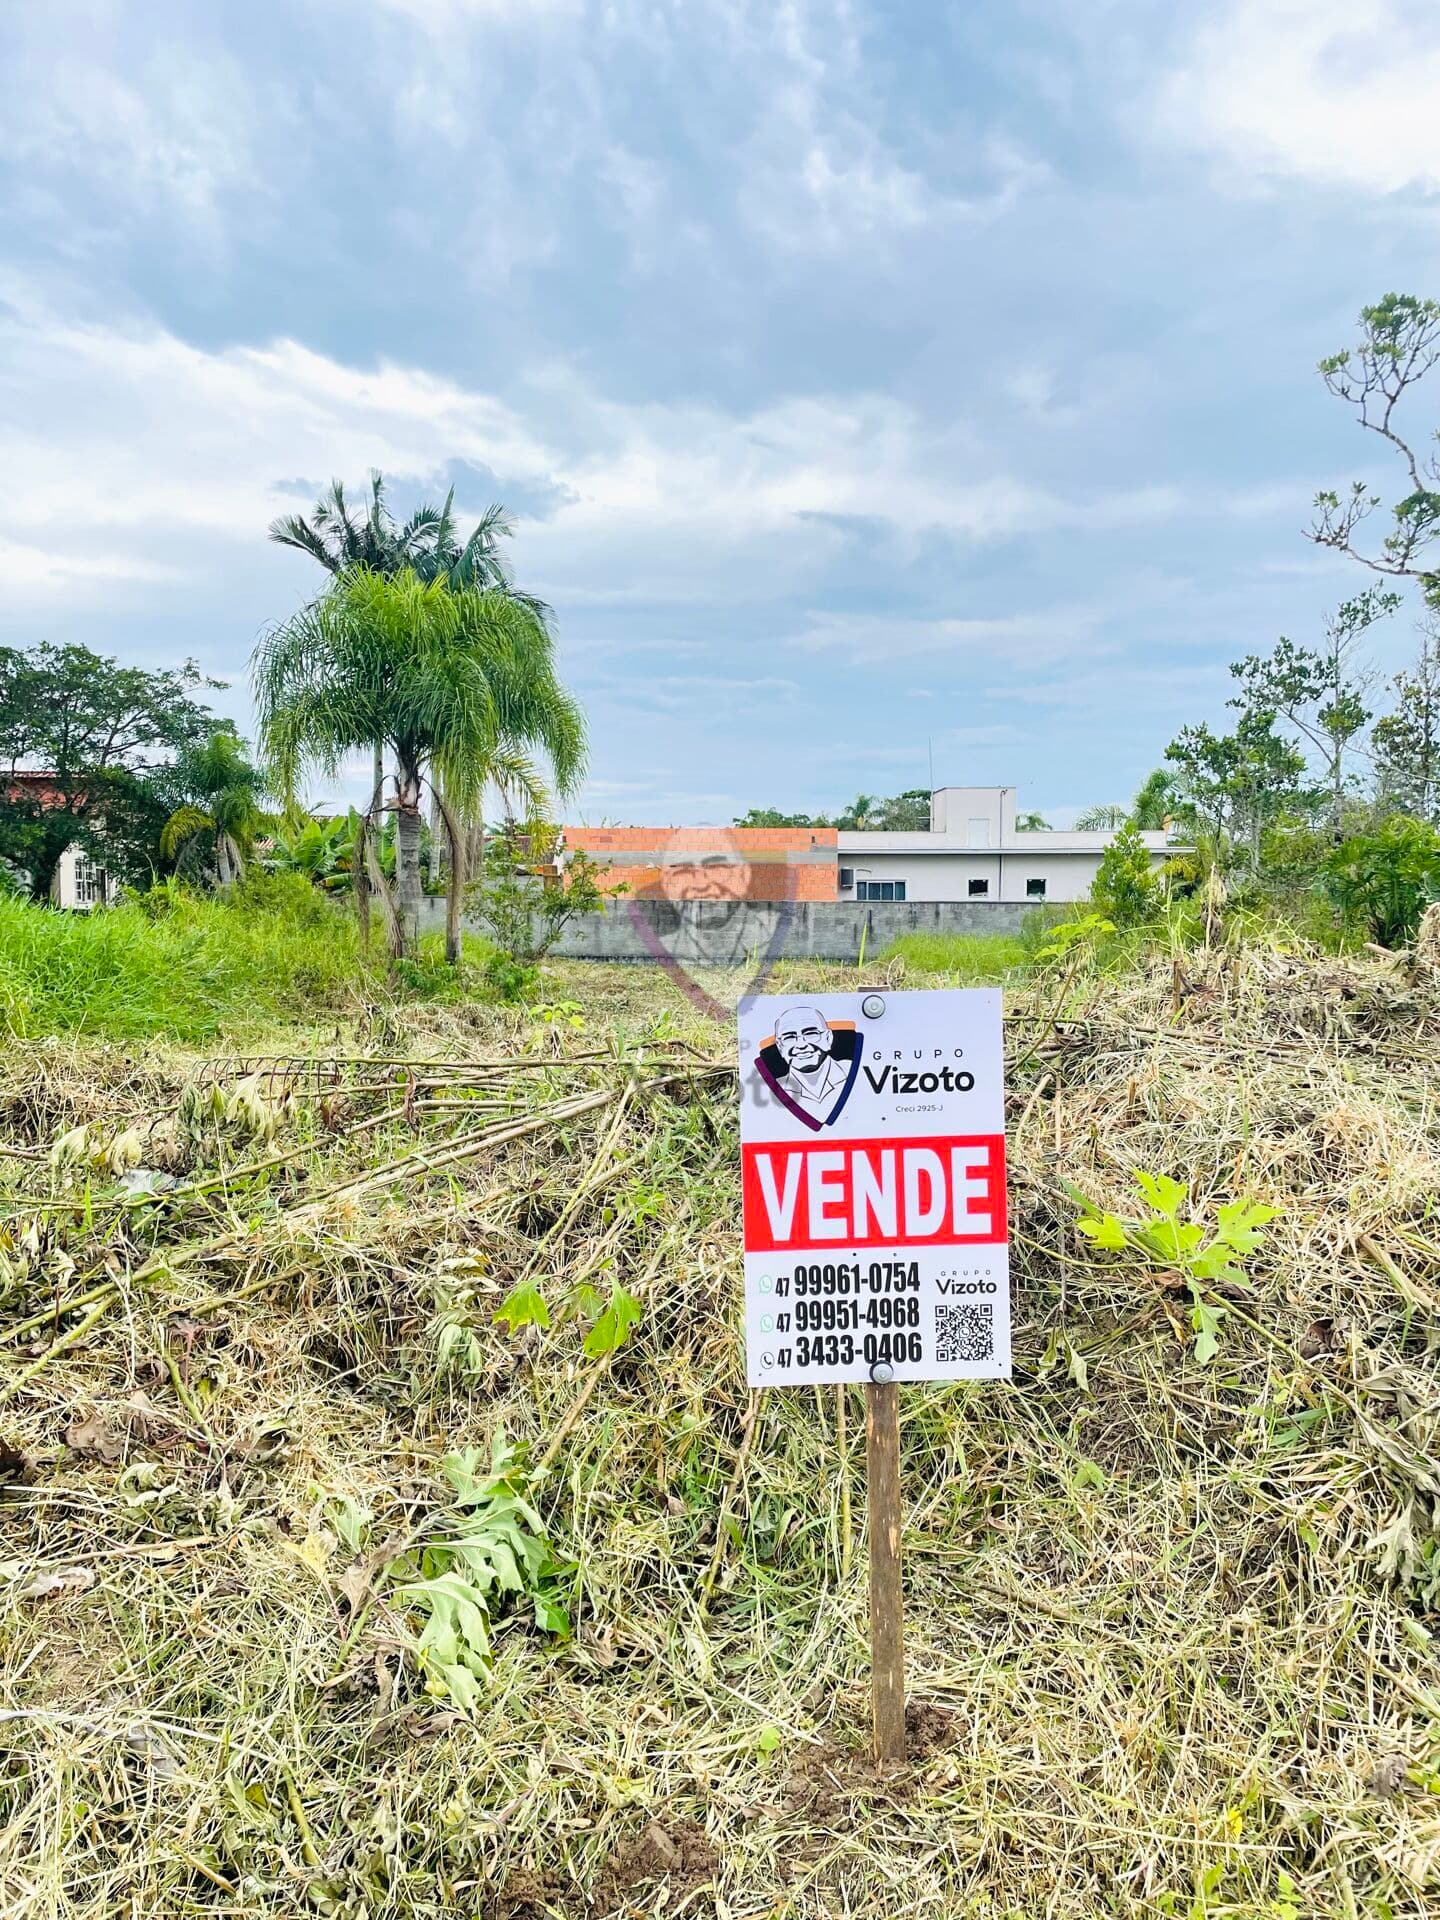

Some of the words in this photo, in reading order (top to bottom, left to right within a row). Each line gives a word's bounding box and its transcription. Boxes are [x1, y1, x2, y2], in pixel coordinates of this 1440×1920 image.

[872, 1048, 964, 1061] GRUPO
[863, 1064, 975, 1095] Vizoto
[895, 1105, 915, 1113] Creci
[916, 1104, 944, 1112] 2925-J
[754, 1145, 993, 1242] VENDE
[775, 1277, 790, 1298] 47
[794, 1261, 921, 1297] 99961-0754
[935, 1278, 997, 1296] Vizoto
[940, 1269, 991, 1277] GRUPO
[776, 1313, 791, 1333] 47
[795, 1297, 920, 1332] 99951-4968
[777, 1348, 792, 1368] 47
[796, 1332, 923, 1368] 3433-0406
